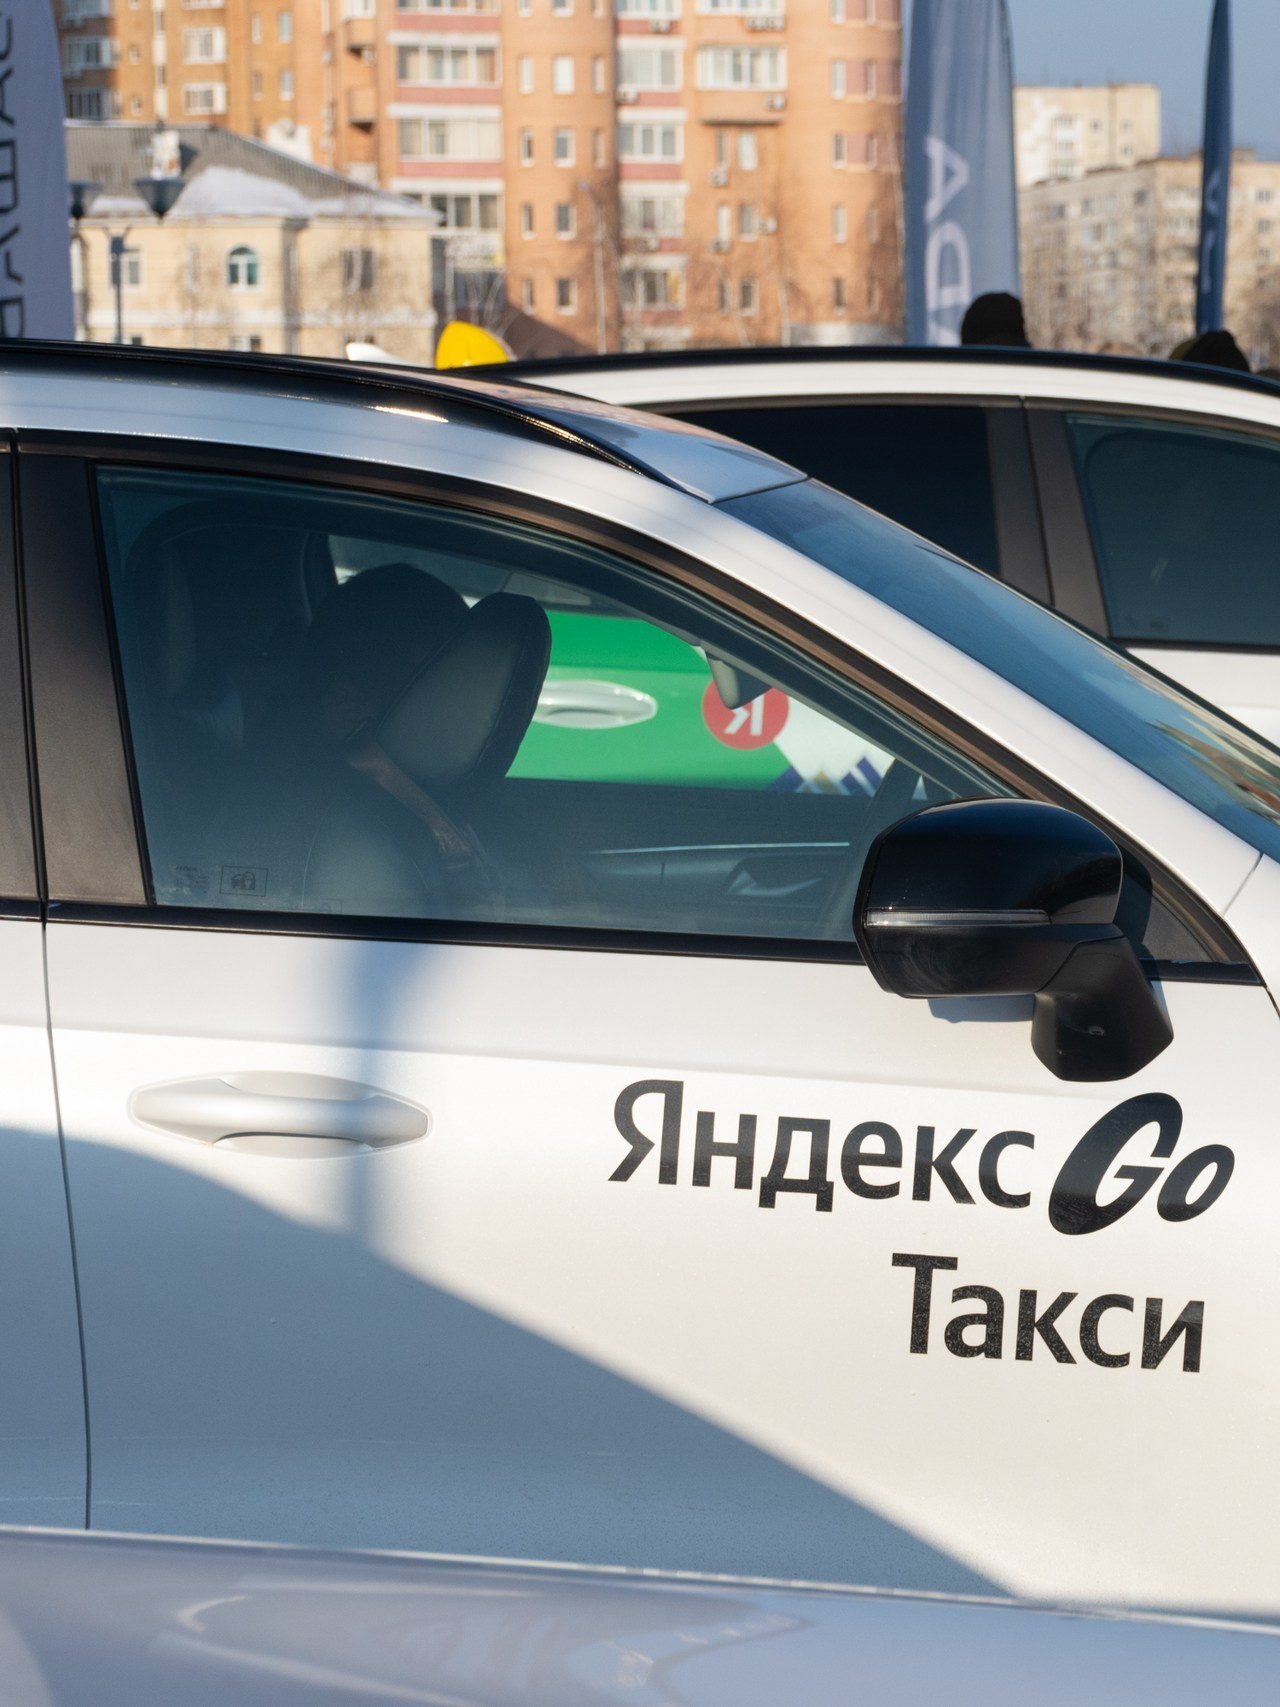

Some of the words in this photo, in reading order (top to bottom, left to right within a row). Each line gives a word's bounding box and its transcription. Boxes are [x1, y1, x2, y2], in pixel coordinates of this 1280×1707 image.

[608, 1079, 1035, 1213] Яндекс
[1048, 1092, 1236, 1236] Go
[891, 1252, 1205, 1373] Такси
